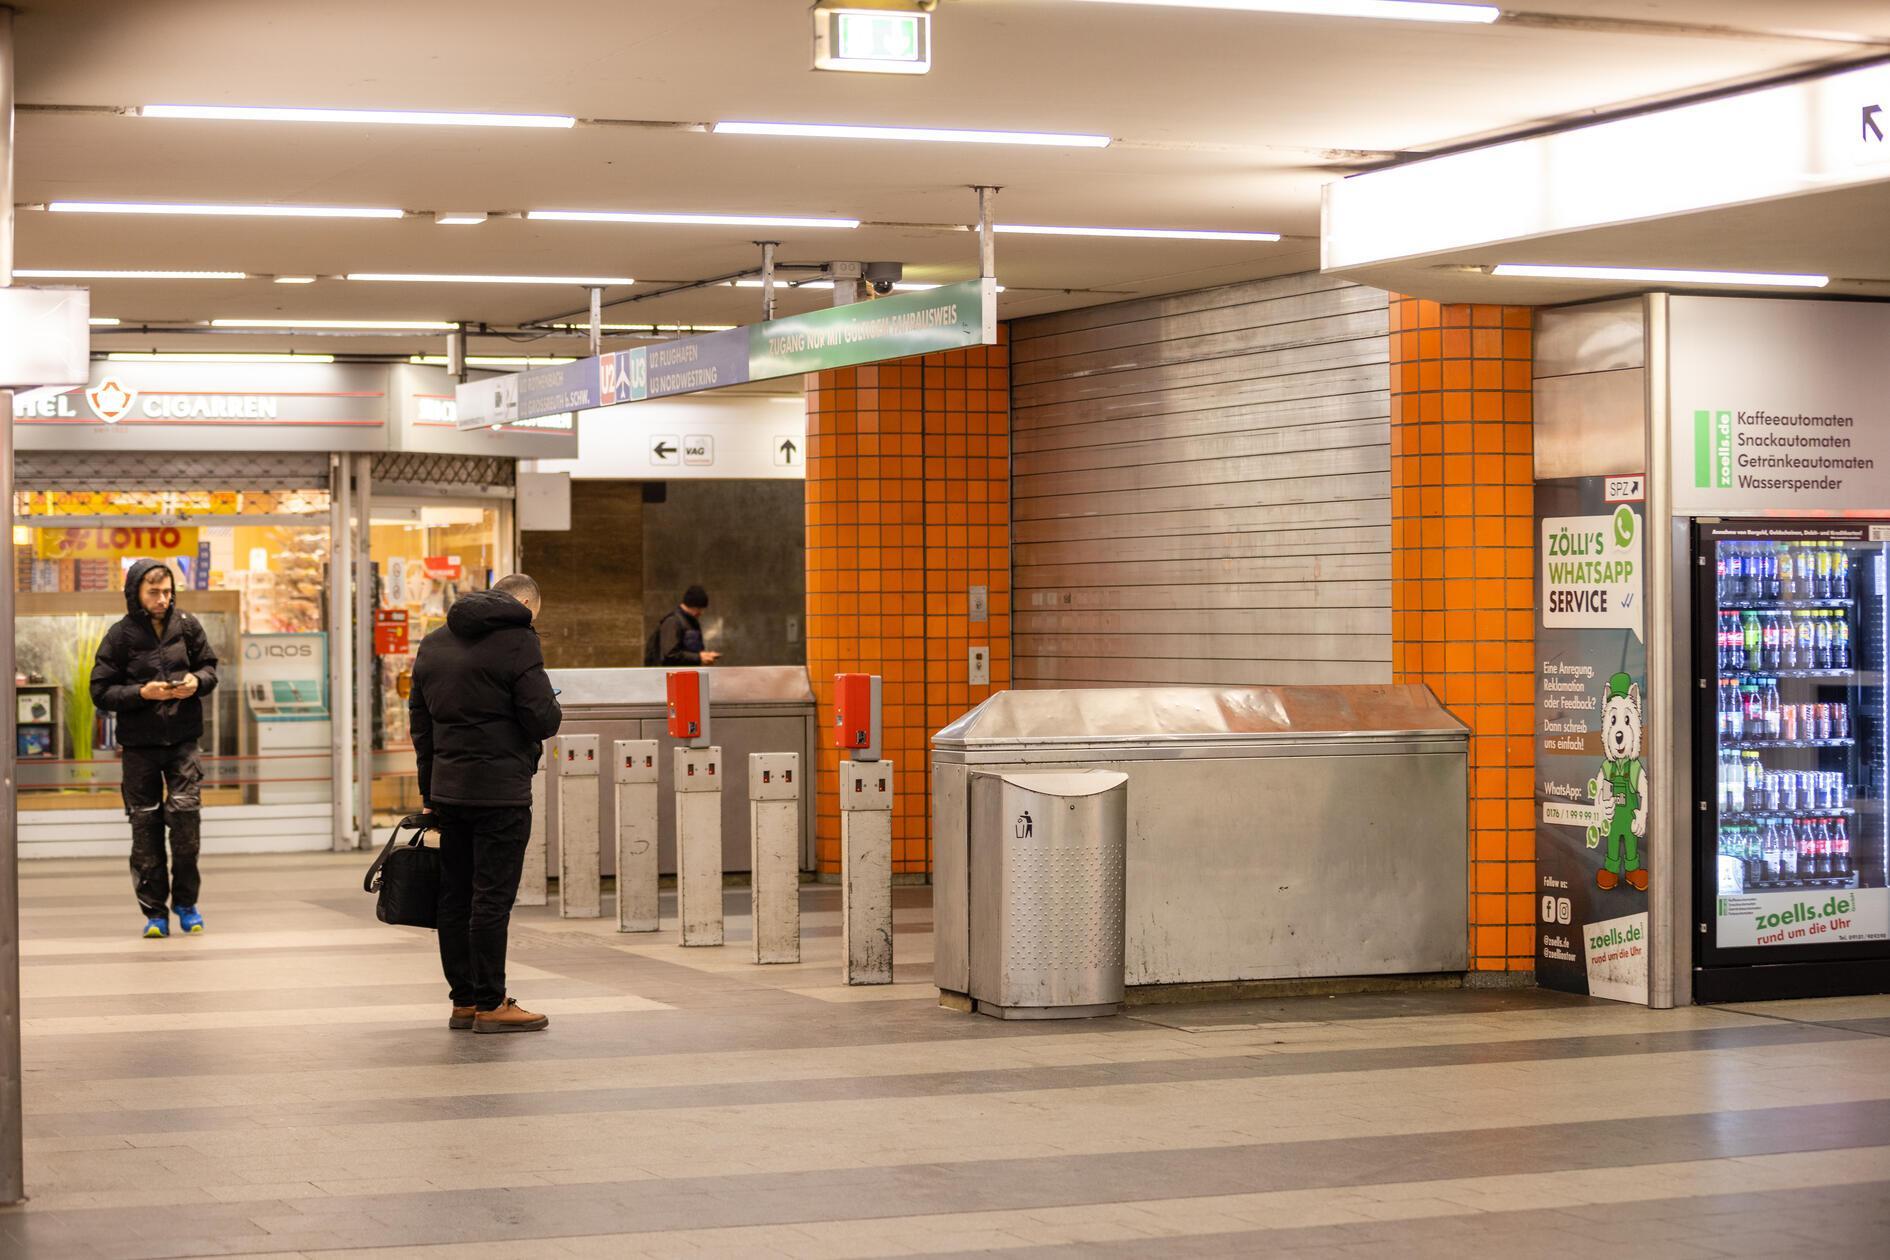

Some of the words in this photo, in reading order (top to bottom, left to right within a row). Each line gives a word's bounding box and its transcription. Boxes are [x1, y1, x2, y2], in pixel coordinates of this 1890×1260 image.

[769, 335, 805, 354] ZUGANG
[807, 331, 825, 350] NUR
[827, 330, 842, 347] MIT
[650, 351, 659, 369] U2
[660, 344, 698, 367] FLUGHAFEN
[601, 364, 616, 394] U2
[631, 357, 646, 388] U3
[650, 376, 660, 393] U3
[660, 366, 718, 393] NORDWESTRING
[142, 395, 278, 418] CIGARREN
[1737, 411, 1854, 427] Kaffeeautomaten
[1737, 432, 1851, 448] Snackautomaten
[686, 447, 705, 456] VAG
[1718, 414, 1730, 486] zoells.de
[1737, 453, 1875, 469] Getränkeautomaten
[1610, 482, 1629, 497] SPZ
[1738, 475, 1843, 492] Wasserspender
[96, 527, 181, 550] LOTTO
[1548, 560, 1633, 584] WHATSAPP
[1549, 590, 1608, 613] SERVICE
[264, 645, 313, 658] IQOS
[1543, 661, 1557, 674] Eine
[1559, 662, 1595, 679] Anregung,
[1543, 680, 1584, 692] Reklamation
[1543, 695, 1559, 709] oder
[1560, 697, 1596, 710] Feedback?
[1544, 720, 1562, 732] Dann
[1563, 720, 1588, 733] schreib
[1544, 739, 1557, 750] uns
[1558, 737, 1584, 750] einfach!
[1544, 782, 1582, 800] WhatsApp:
[1543, 876, 1559, 887] Follow
[1755, 896, 1850, 930] zoells.de
[1590, 924, 1641, 949] zoells.de
[1757, 930, 1785, 945] rund
[1788, 928, 1806, 940] um
[1809, 923, 1827, 935] die
[1830, 918, 1851, 931] Uhr
[1591, 952, 1607, 965] rund
[1608, 950, 1618, 961] um
[1619, 948, 1629, 959] die
[1630, 945, 1642, 956] Uhr
